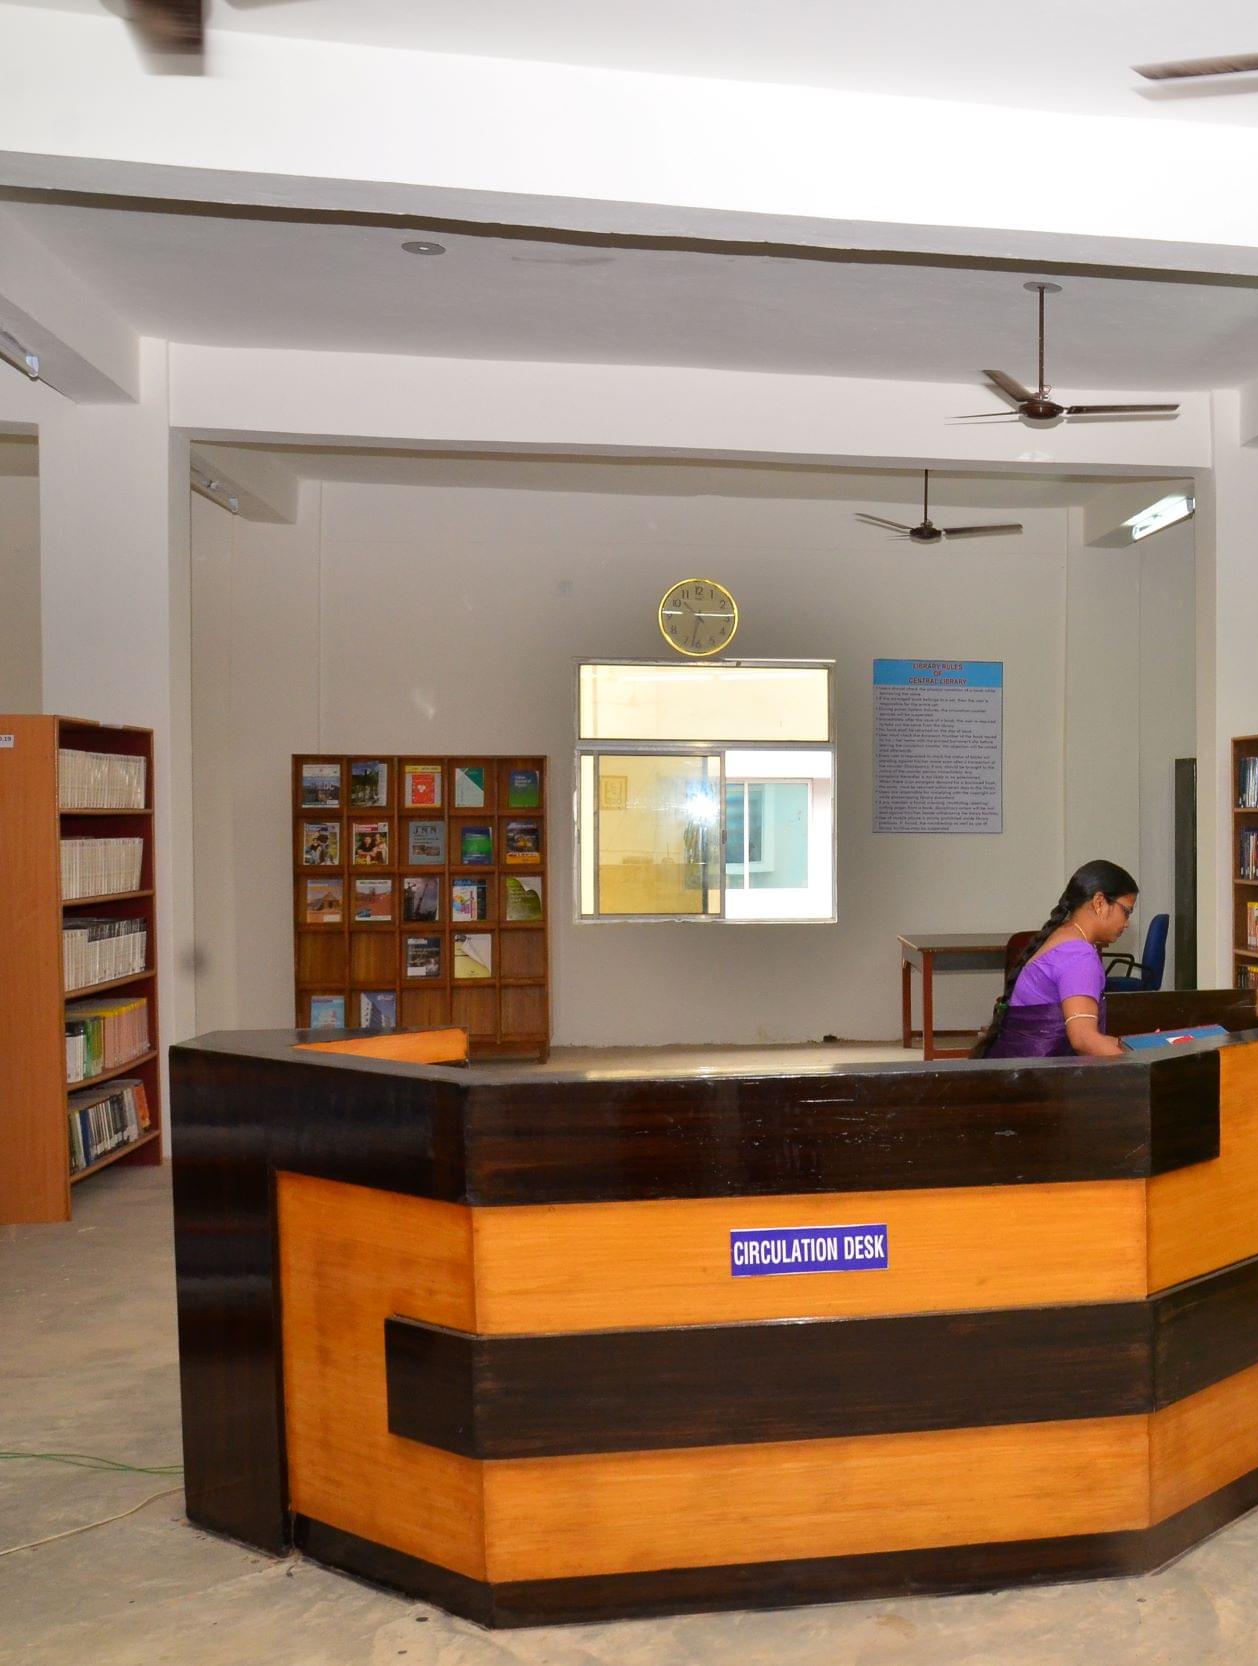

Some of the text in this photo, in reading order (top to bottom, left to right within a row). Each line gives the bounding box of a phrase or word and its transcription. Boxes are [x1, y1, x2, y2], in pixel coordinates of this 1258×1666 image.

[681, 590, 689, 599] 11
[695, 587, 703, 595] 12
[710, 590, 714, 598] 1
[720, 600, 725, 608] 2
[695, 639, 701, 648] 6
[733, 1235, 884, 1265] CIRCULATION DESK
